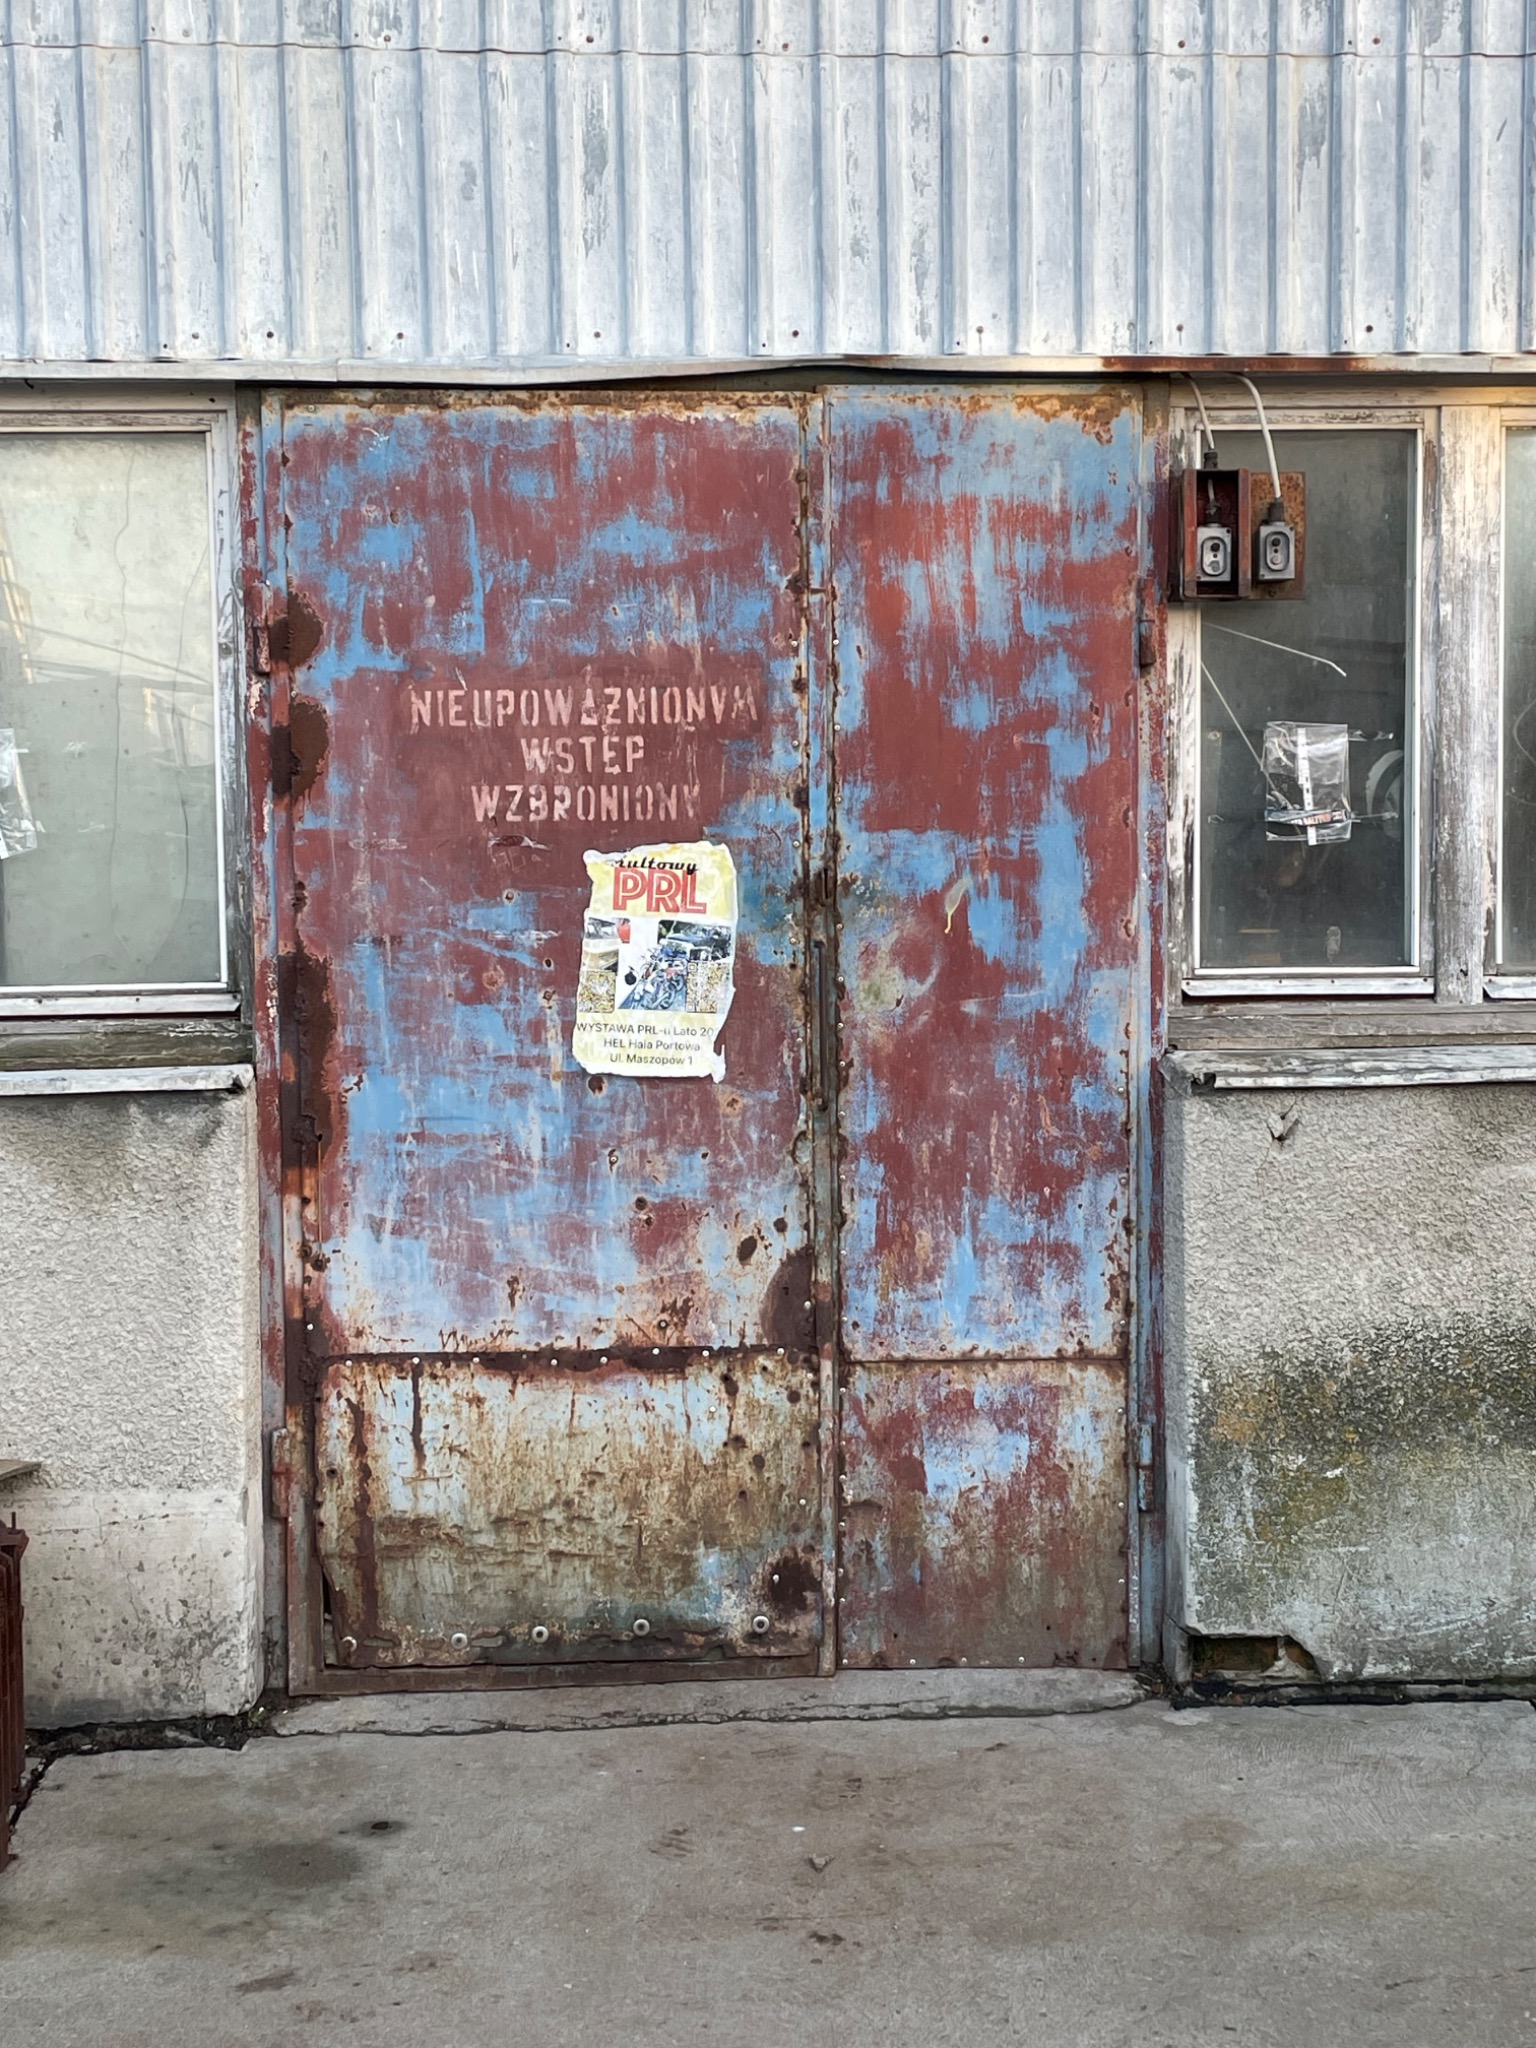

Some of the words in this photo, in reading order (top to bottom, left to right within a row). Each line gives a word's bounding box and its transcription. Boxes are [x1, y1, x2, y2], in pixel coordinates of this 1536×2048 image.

[613, 867, 707, 914] PRL
[576, 1022, 635, 1034] WYSTAWA
[673, 1026, 697, 1036] Lato
[603, 1038, 626, 1048] HEL
[655, 1040, 701, 1051] Portowa
[687, 1056, 693, 1065] 1
